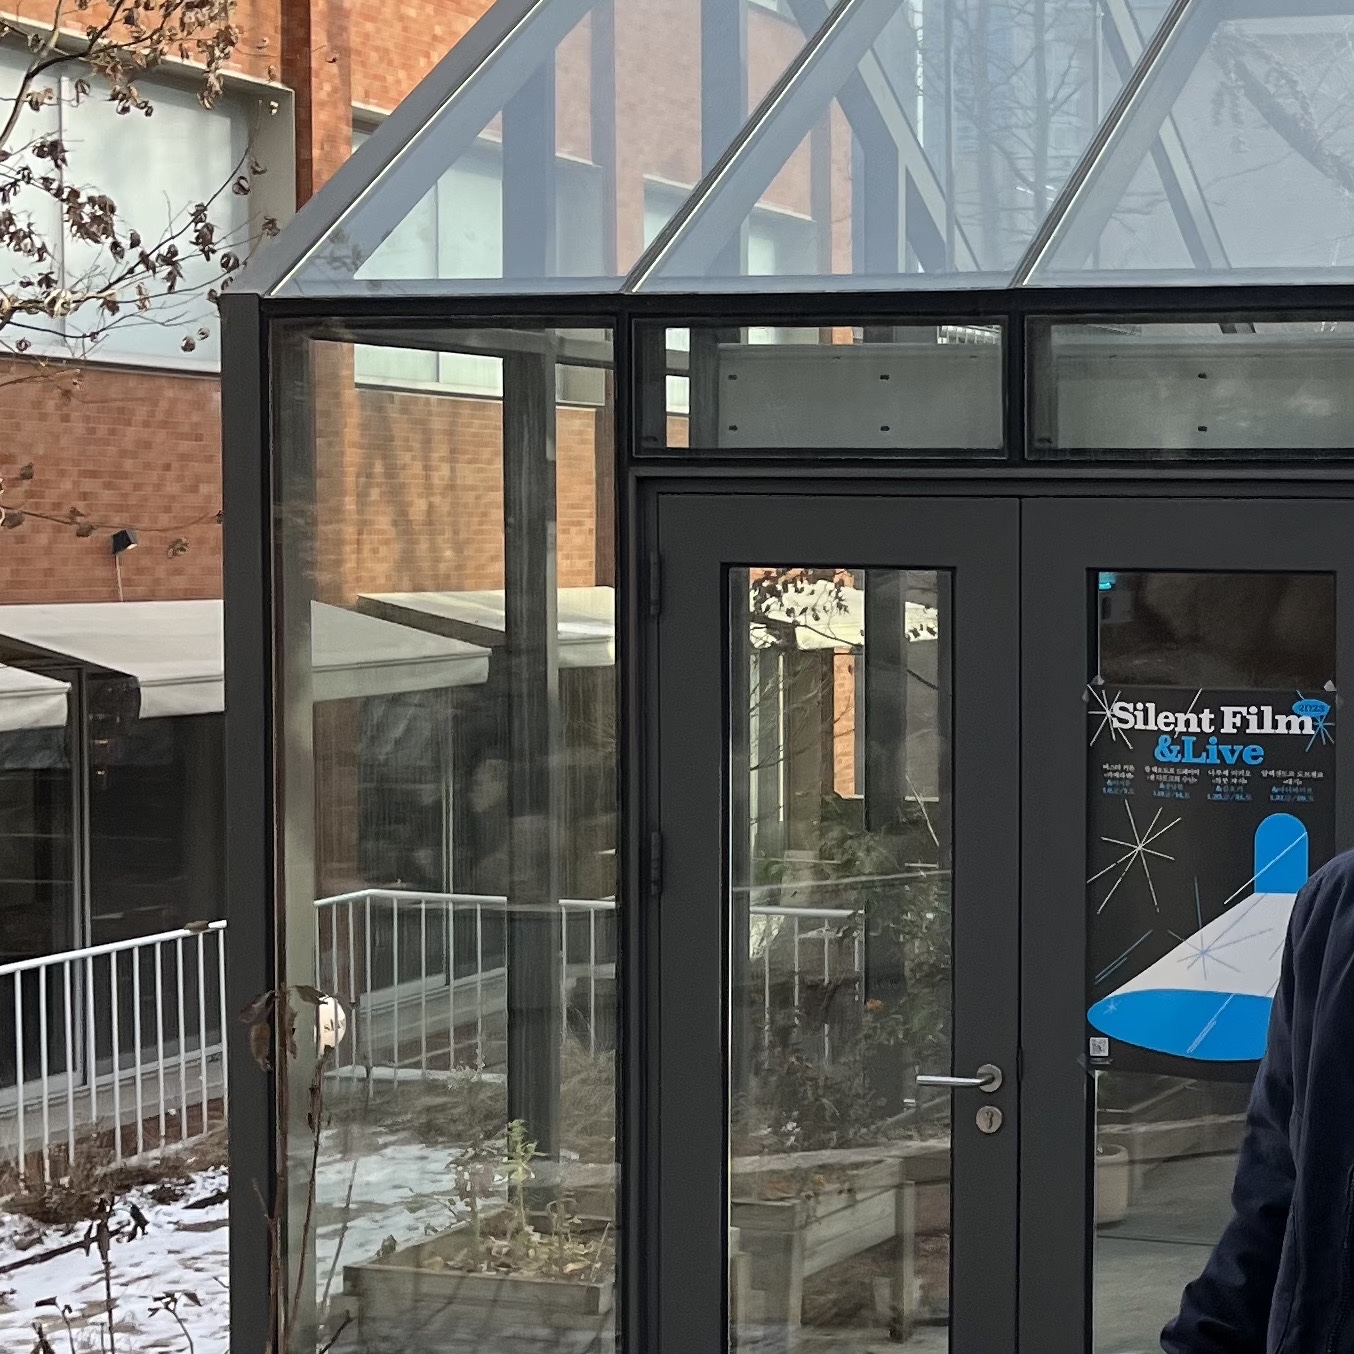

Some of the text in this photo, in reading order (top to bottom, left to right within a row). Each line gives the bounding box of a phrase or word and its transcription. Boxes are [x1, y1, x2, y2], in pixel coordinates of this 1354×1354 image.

[1112, 701, 1315, 735] Silent Film
[1154, 734, 1265, 765] &Live
